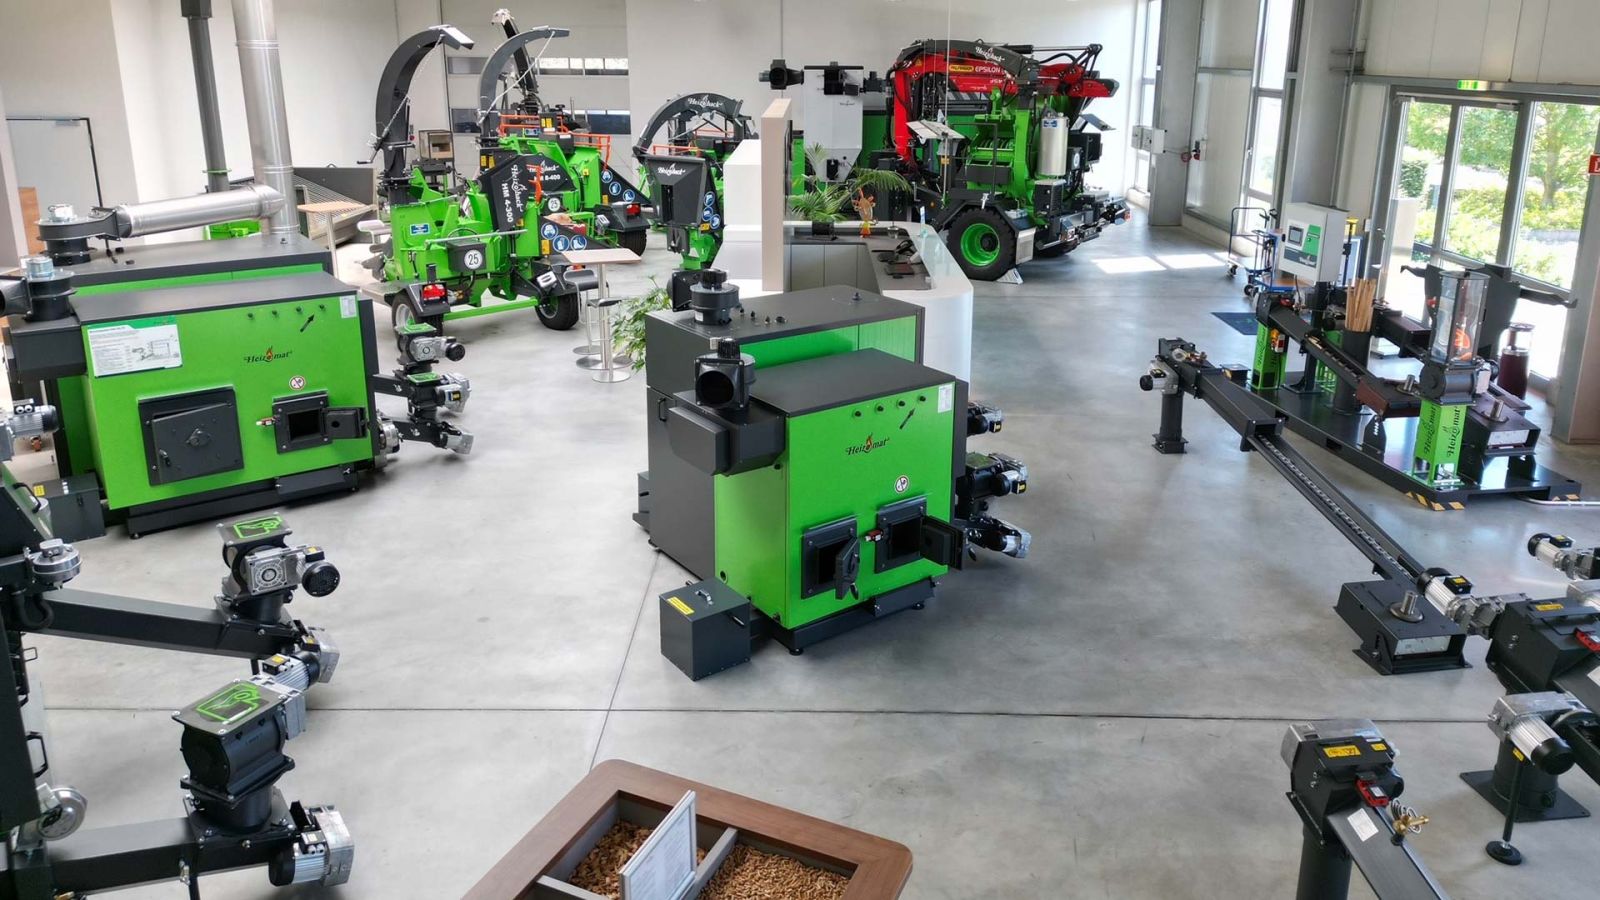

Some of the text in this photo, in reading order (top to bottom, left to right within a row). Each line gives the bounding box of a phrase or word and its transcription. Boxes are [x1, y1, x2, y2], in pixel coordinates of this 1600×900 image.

[501, 183, 514, 223] HM 4-300
[550, 198, 559, 209] 25
[468, 253, 479, 266] 25
[243, 346, 293, 364] Heizomat
[845, 432, 890, 456] Heizomat
